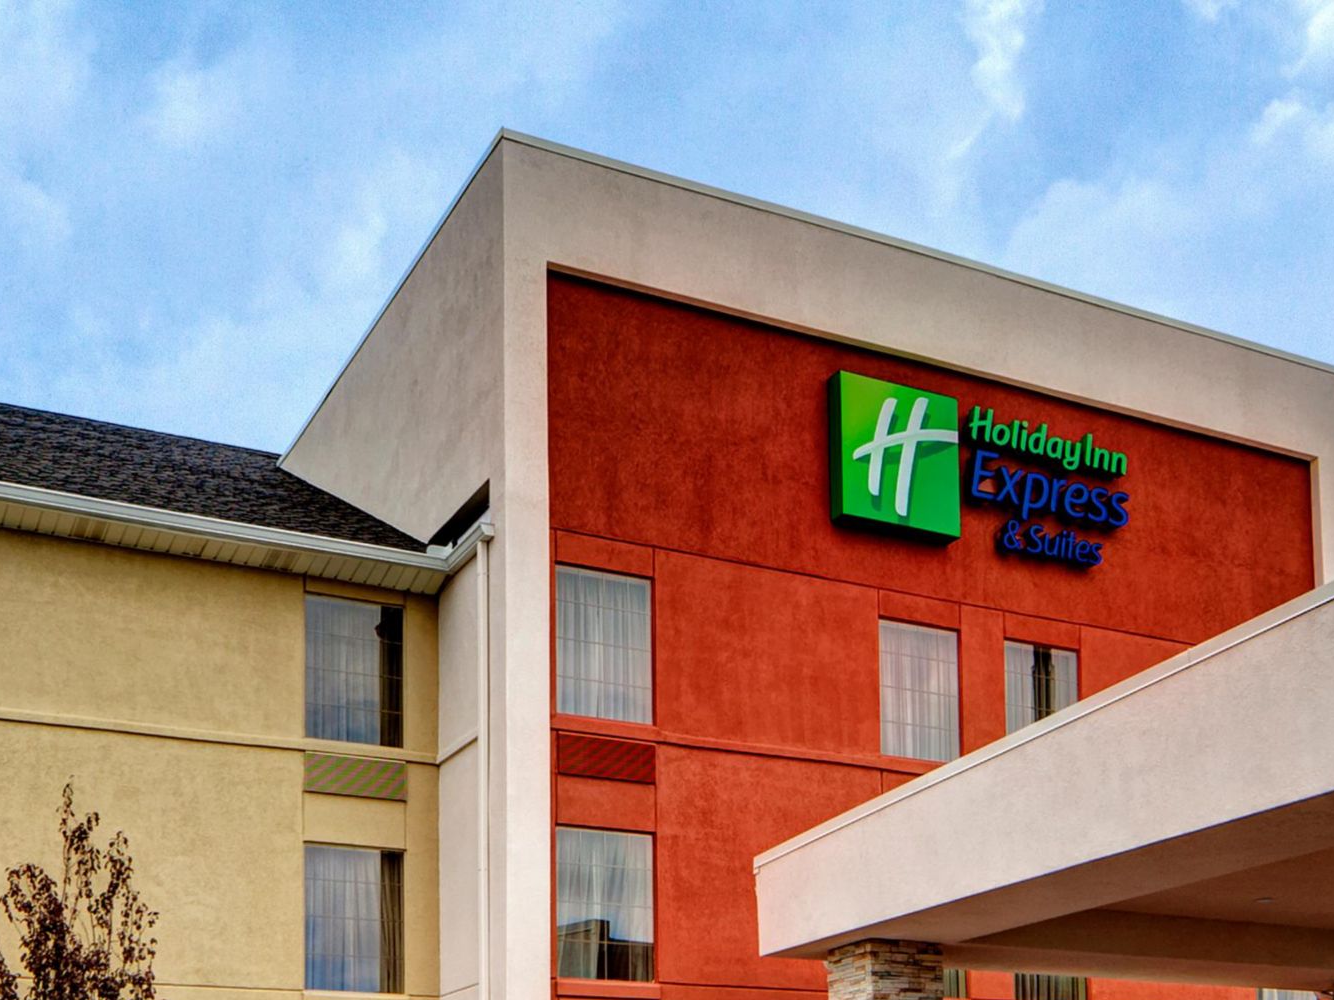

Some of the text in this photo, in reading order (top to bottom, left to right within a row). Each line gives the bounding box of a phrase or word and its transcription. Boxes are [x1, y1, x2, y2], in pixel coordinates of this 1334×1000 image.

[971, 449, 1129, 528] Express
[1003, 519, 1103, 566] & Suites
